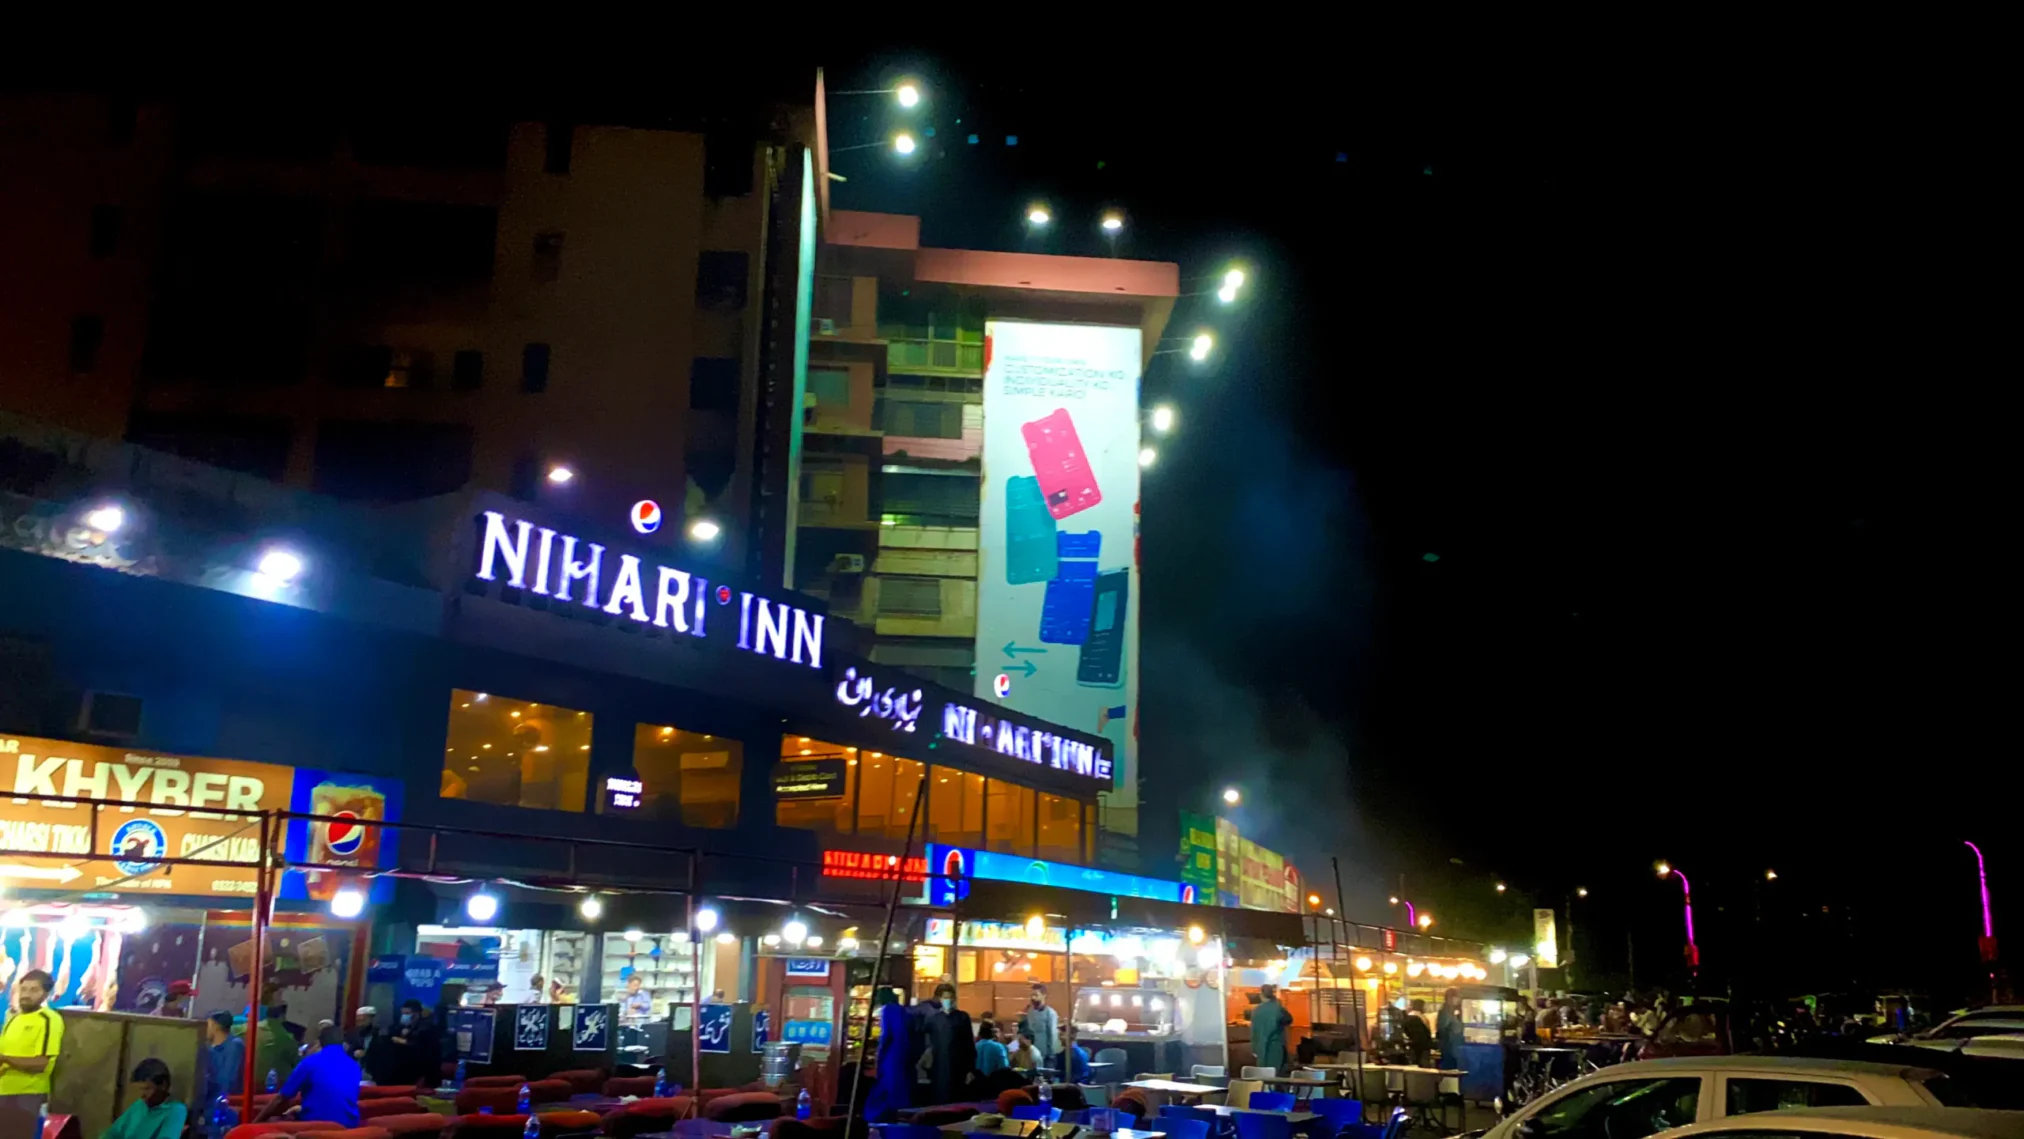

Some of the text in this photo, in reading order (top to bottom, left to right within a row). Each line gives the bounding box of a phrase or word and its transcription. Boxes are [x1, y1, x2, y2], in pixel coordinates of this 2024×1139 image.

[476, 510, 825, 668] NIHARI INN
[12, 754, 264, 822] KHYBER
